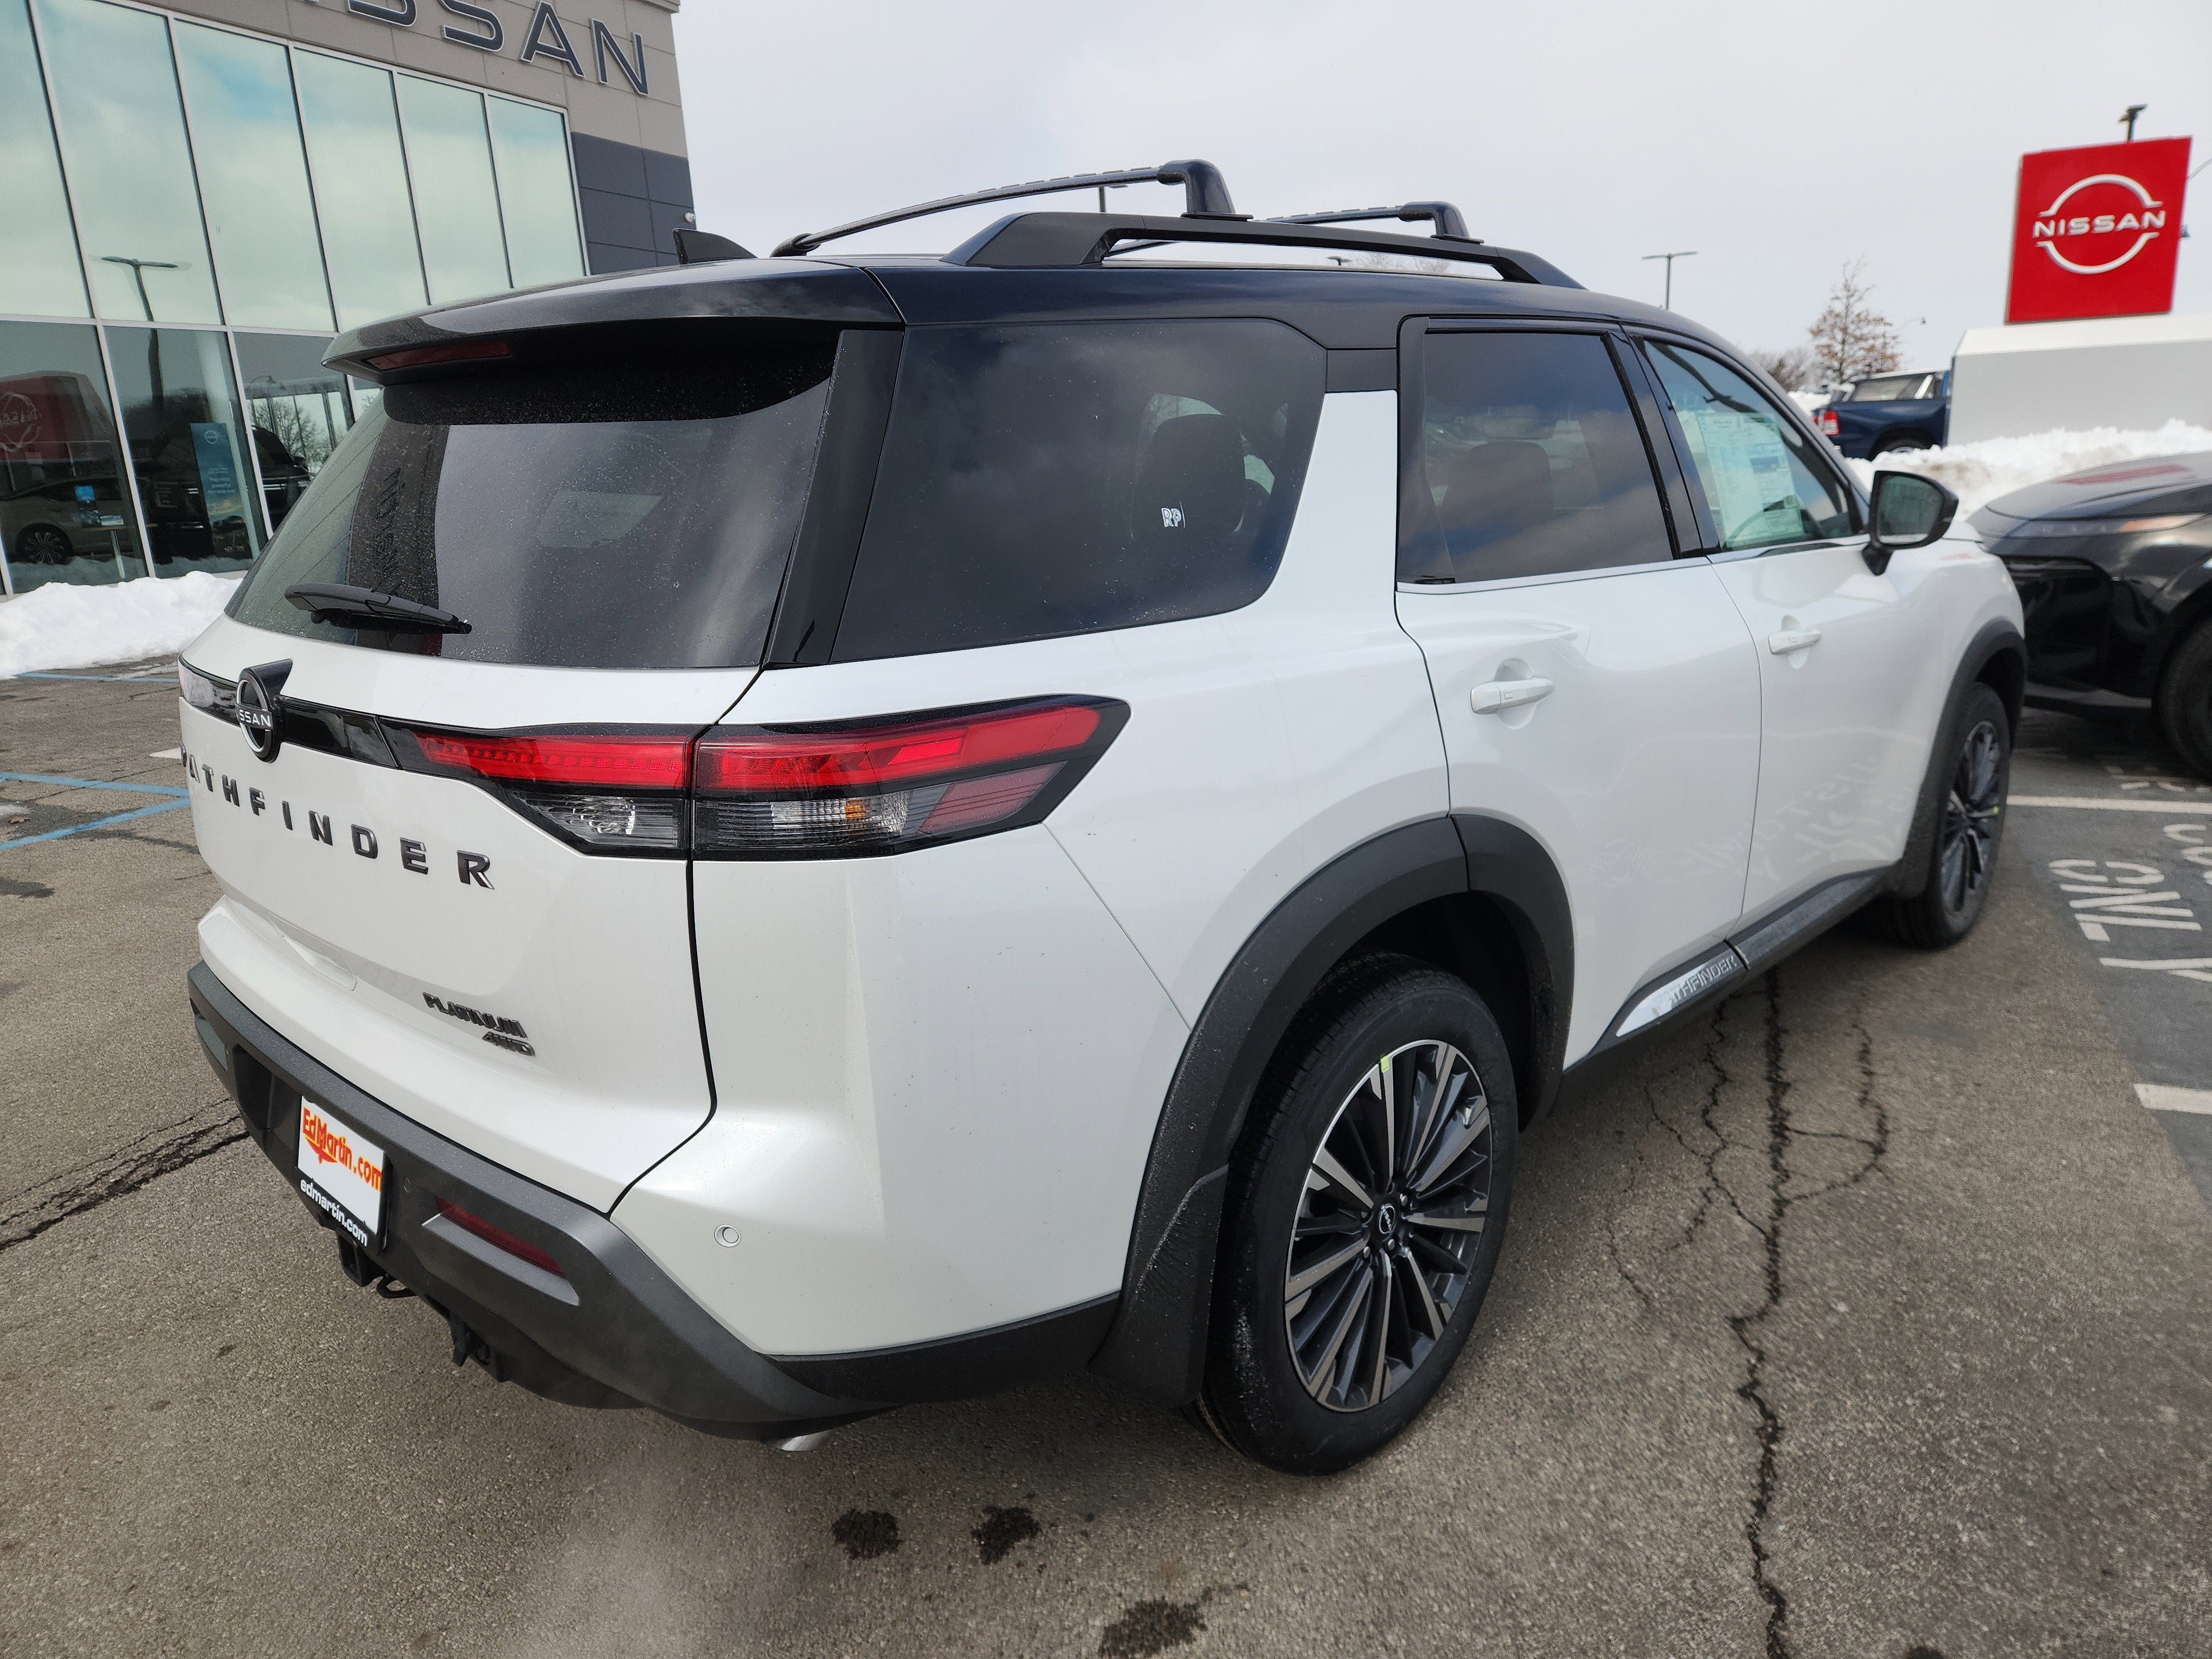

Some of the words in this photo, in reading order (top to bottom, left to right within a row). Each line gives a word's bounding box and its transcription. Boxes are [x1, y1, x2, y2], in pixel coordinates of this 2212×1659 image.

[304, 0, 649, 95] SAN
[2033, 210, 2166, 239] NISSAN
[239, 709, 271, 727] SSAN
[300, 1179, 368, 1247] edmartin.com
